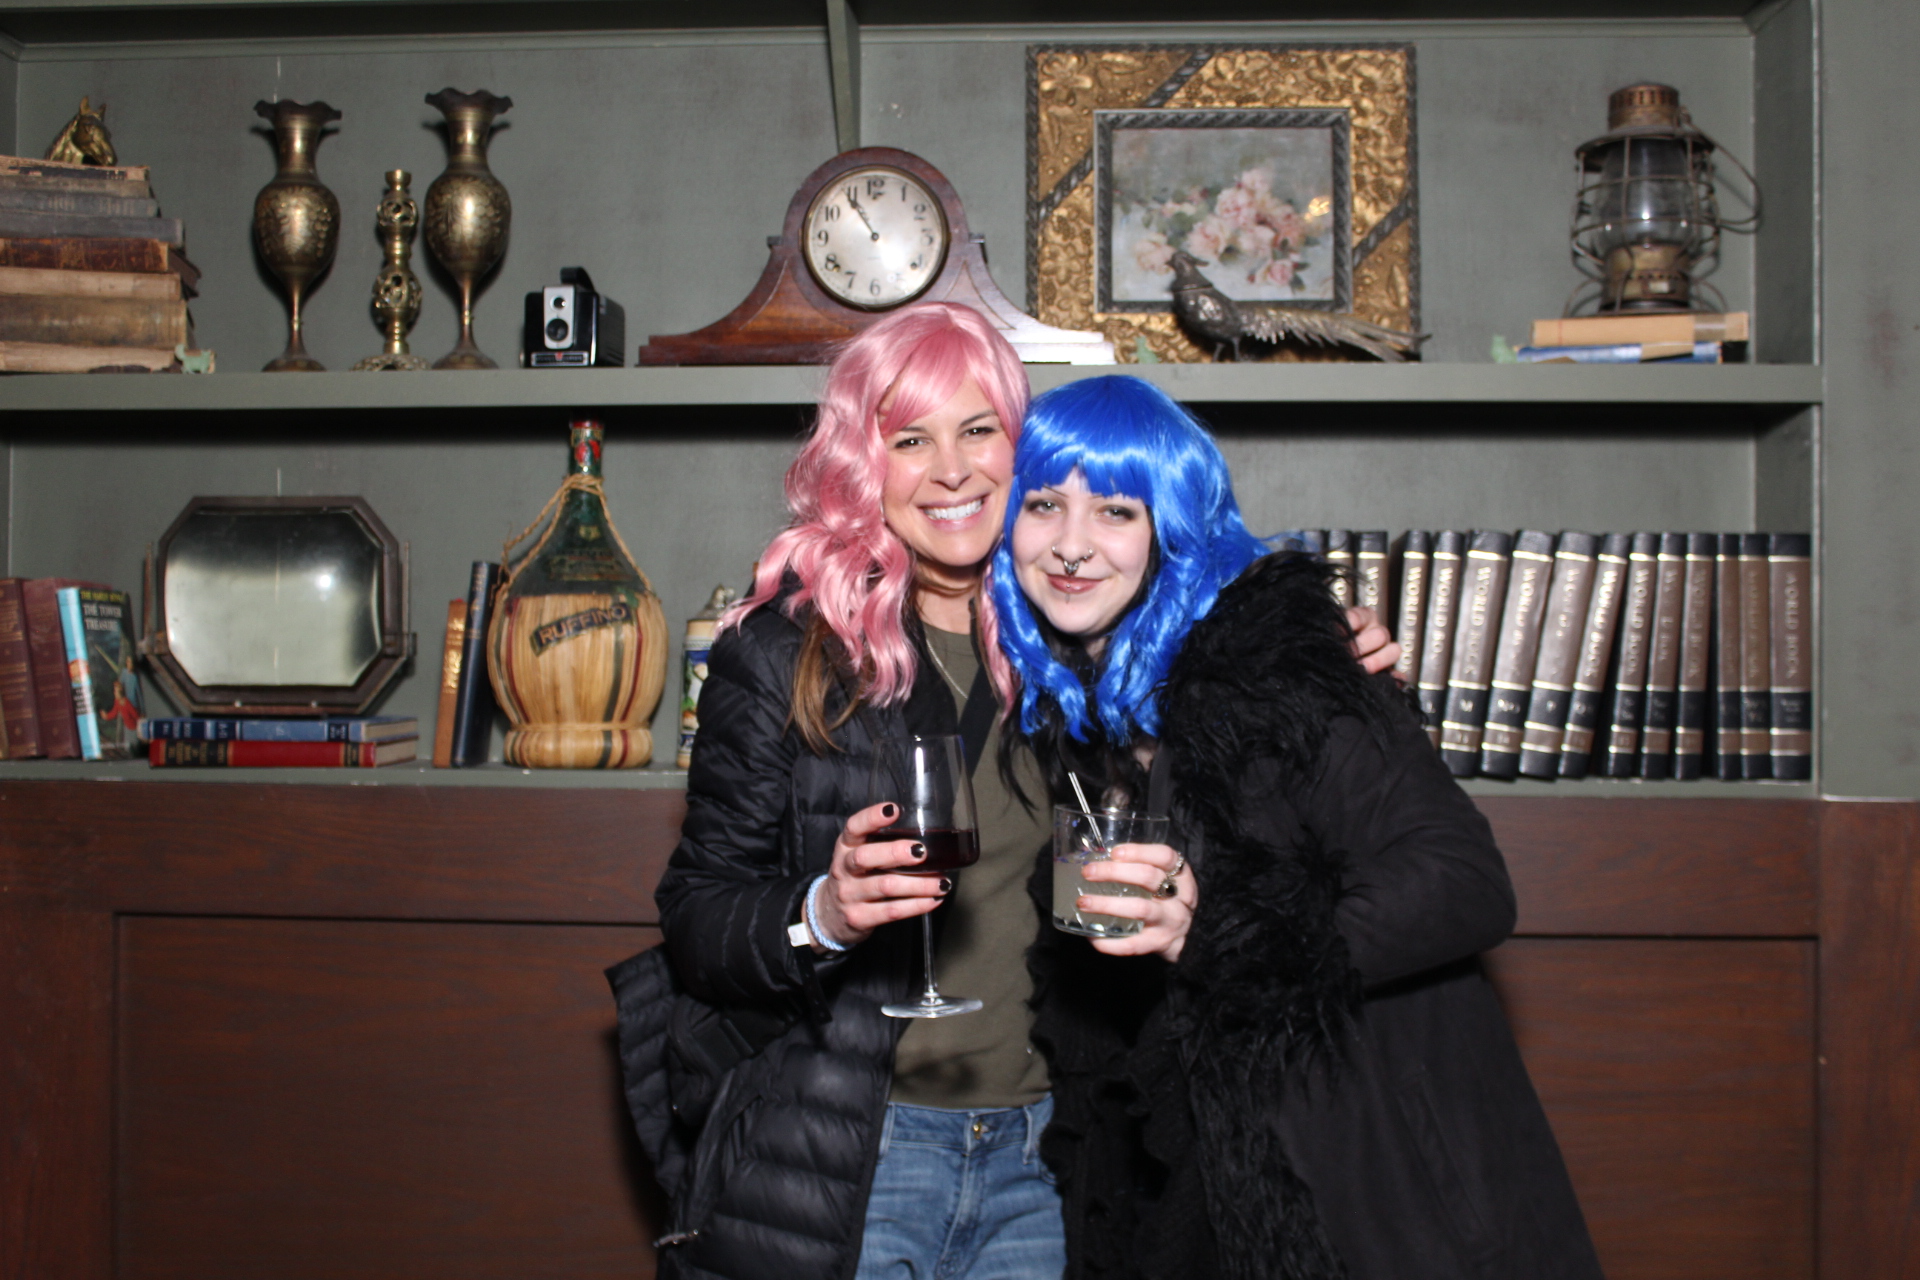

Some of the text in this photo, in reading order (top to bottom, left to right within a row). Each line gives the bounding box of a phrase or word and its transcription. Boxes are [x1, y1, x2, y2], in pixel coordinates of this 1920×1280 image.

[866, 179, 885, 200] 12
[900, 183, 908, 202] 1
[824, 205, 841, 222] 10
[913, 203, 927, 222] 2
[817, 229, 830, 246] 9
[920, 228, 934, 246] 3
[825, 253, 839, 271] 8
[845, 271, 857, 289] 7
[869, 279, 881, 297] 6
[1405, 566, 1422, 626] WORLD
[1435, 567, 1453, 627] WORLD
[1472, 566, 1491, 626] WORLD
[83, 603, 98, 616] THE
[538, 604, 627, 645] RUFFINO
